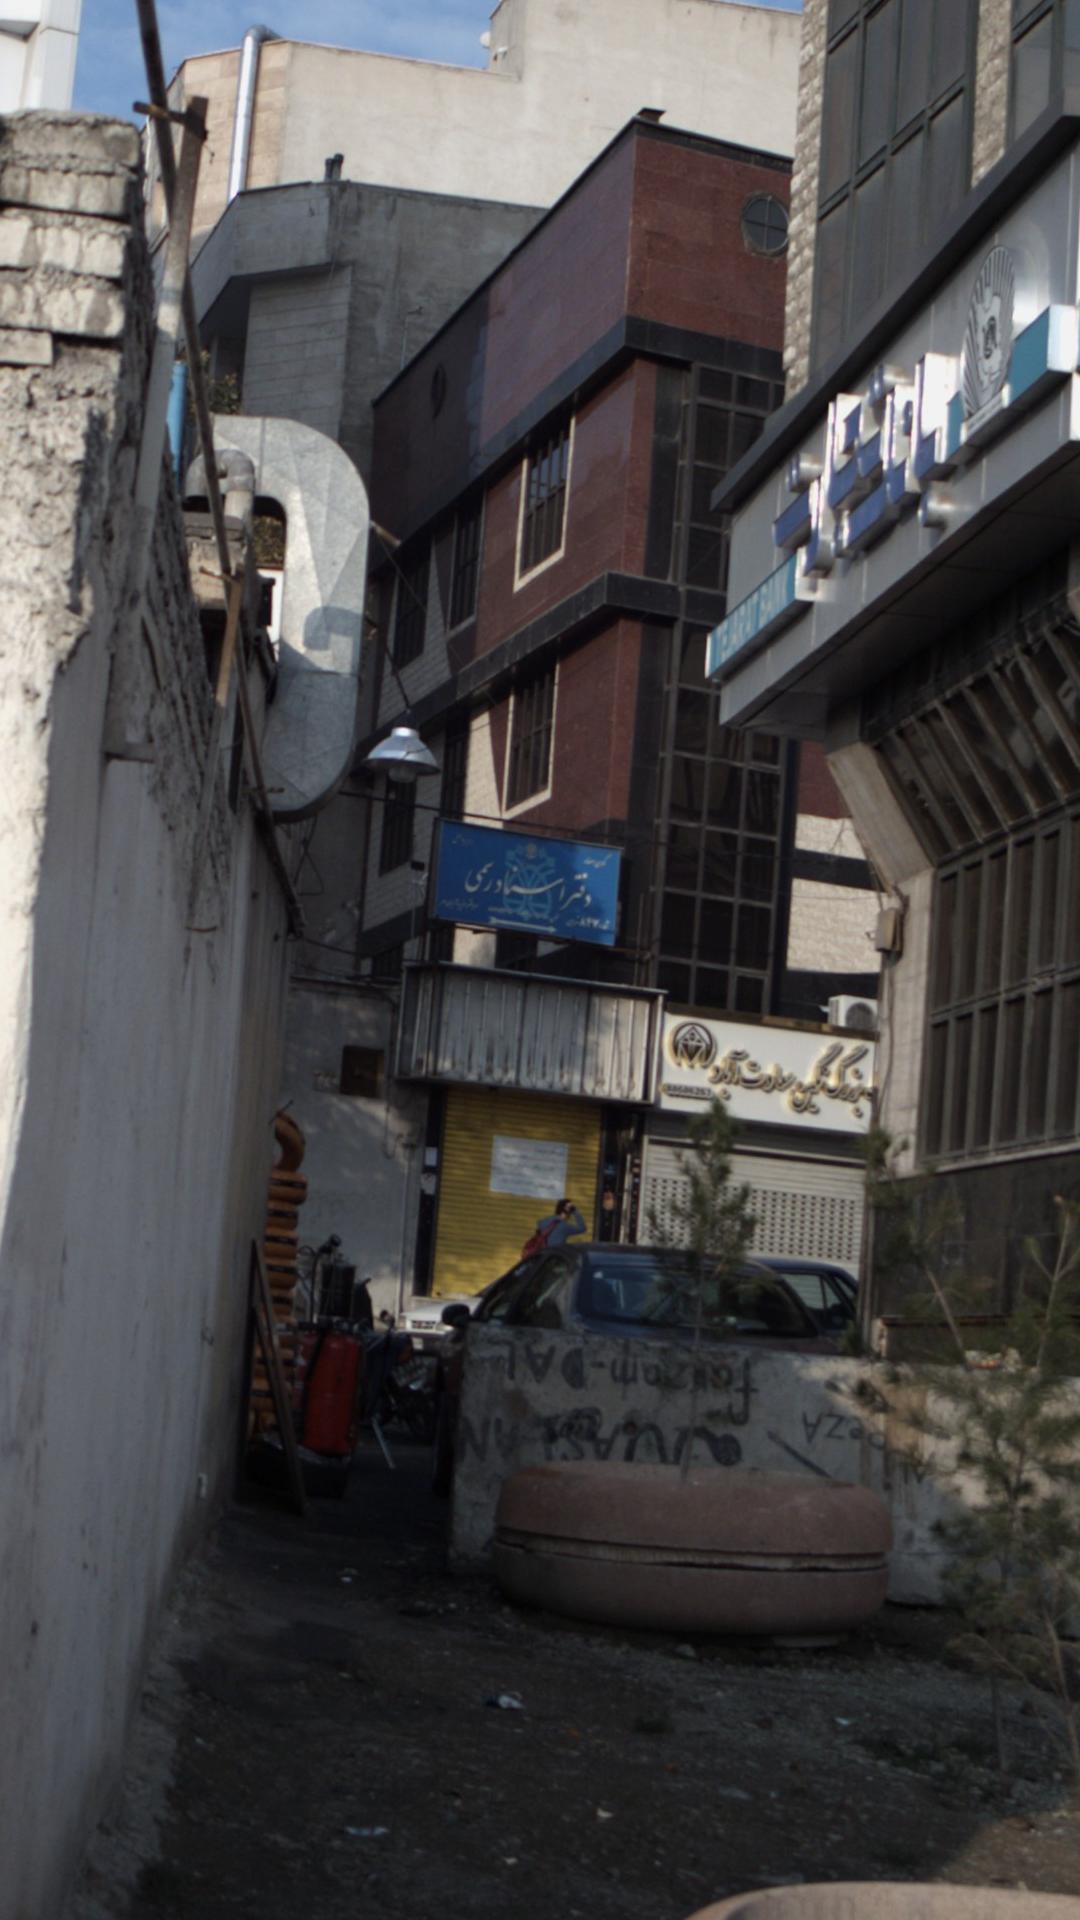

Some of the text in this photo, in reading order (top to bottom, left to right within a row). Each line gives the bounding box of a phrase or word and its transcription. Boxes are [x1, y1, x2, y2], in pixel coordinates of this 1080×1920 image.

[464, 861, 593, 912] دفتر اسناد رسمی
